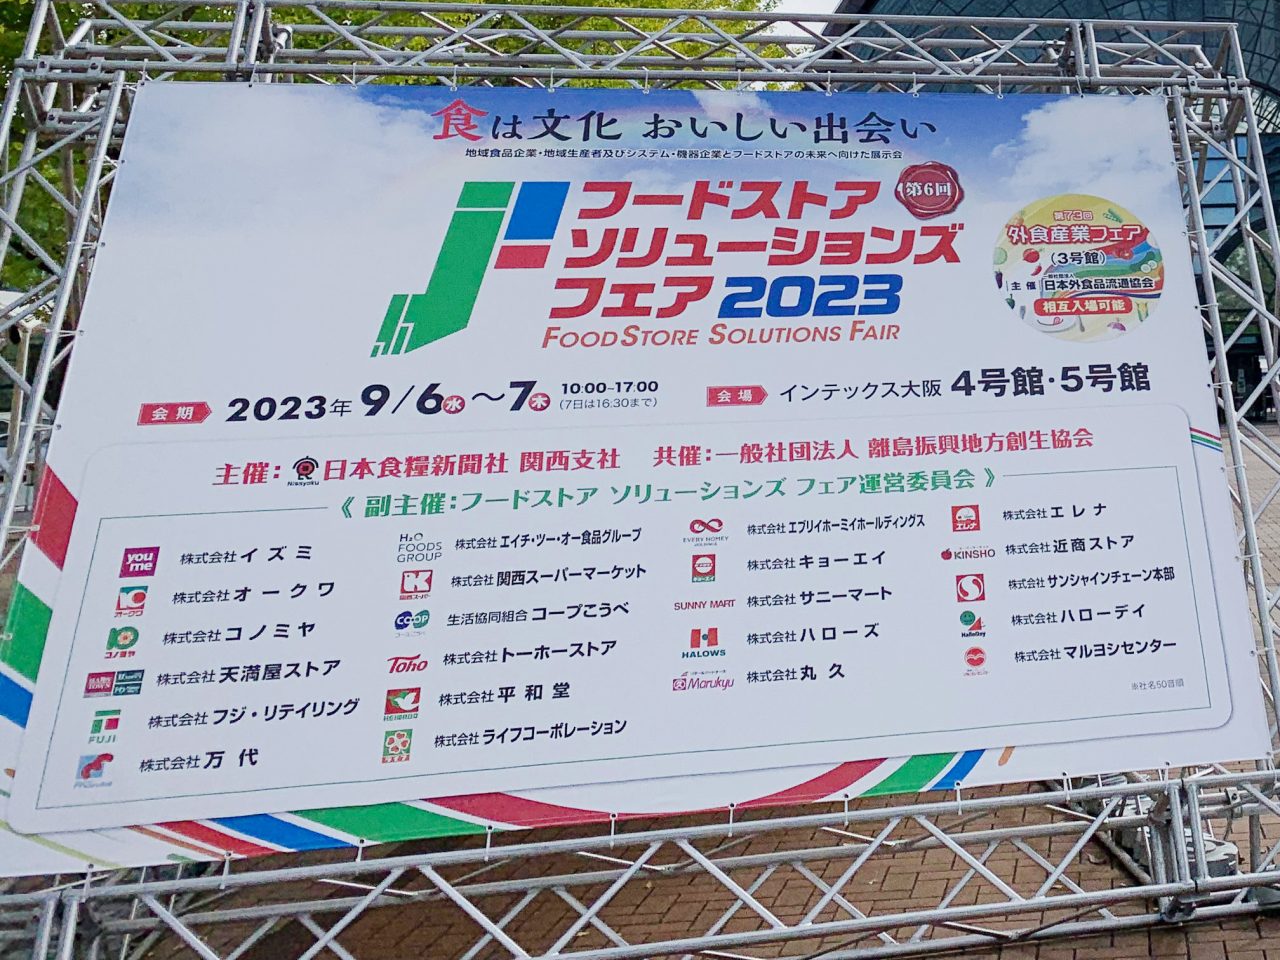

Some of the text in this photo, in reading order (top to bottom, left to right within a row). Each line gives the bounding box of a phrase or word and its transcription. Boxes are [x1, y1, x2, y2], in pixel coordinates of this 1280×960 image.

[431, 99, 937, 142] 食は文化 おいしい出会い
[905, 180, 952, 200] 第6回
[577, 181, 881, 220] フードストア
[1007, 224, 1142, 244] 外食産業フェア
[563, 223, 965, 269] ソリューションズ
[1044, 278, 1154, 290] 日本外食品流通協会
[1043, 299, 1126, 314] 相互入場可能
[541, 321, 901, 349] FOOD STORE SOLUTIONS FAIR
[780, 378, 942, 403] インテックス大阪
[224, 396, 353, 422] 2023年
[323, 453, 508, 482] 日本食糧新聞社
[519, 447, 621, 473] 関西支社
[1003, 508, 1047, 521] 株式会社
[747, 523, 786, 535] 株式会社
[398, 542, 442, 552] FOODS
[455, 538, 497, 550] 株式会社
[1005, 542, 1051, 555] 株式会社
[126, 551, 154, 563] you
[180, 551, 237, 565] 株式会社
[397, 552, 442, 562] GROUP
[954, 549, 995, 559] KINSHO
[129, 561, 153, 572] me
[747, 557, 796, 571] 株式会社
[451, 574, 494, 587] 株式会社
[1008, 577, 1045, 590] 株式会社
[171, 590, 230, 605] 株式会社
[747, 594, 796, 607] 株式会社
[674, 599, 736, 611] SUNNY MART
[447, 610, 528, 627] 生活協同組合
[1011, 612, 1057, 626] 株式会社
[162, 630, 222, 646] 株式会社
[747, 631, 796, 645] 株式会社
[443, 650, 498, 665] 株式会社
[681, 650, 726, 658] HALOWS
[1014, 648, 1061, 663] 株式会社
[387, 654, 428, 674] Toho
[156, 670, 216, 686] 株式会社
[688, 676, 734, 691] Marukyu
[747, 670, 797, 684] 株式会社
[438, 690, 494, 706] 株式会社
[147, 712, 208, 729] 株式会社
[88, 735, 116, 744] FUJI
[434, 734, 479, 748] 株式会社
[139, 755, 200, 772] 株式会社
